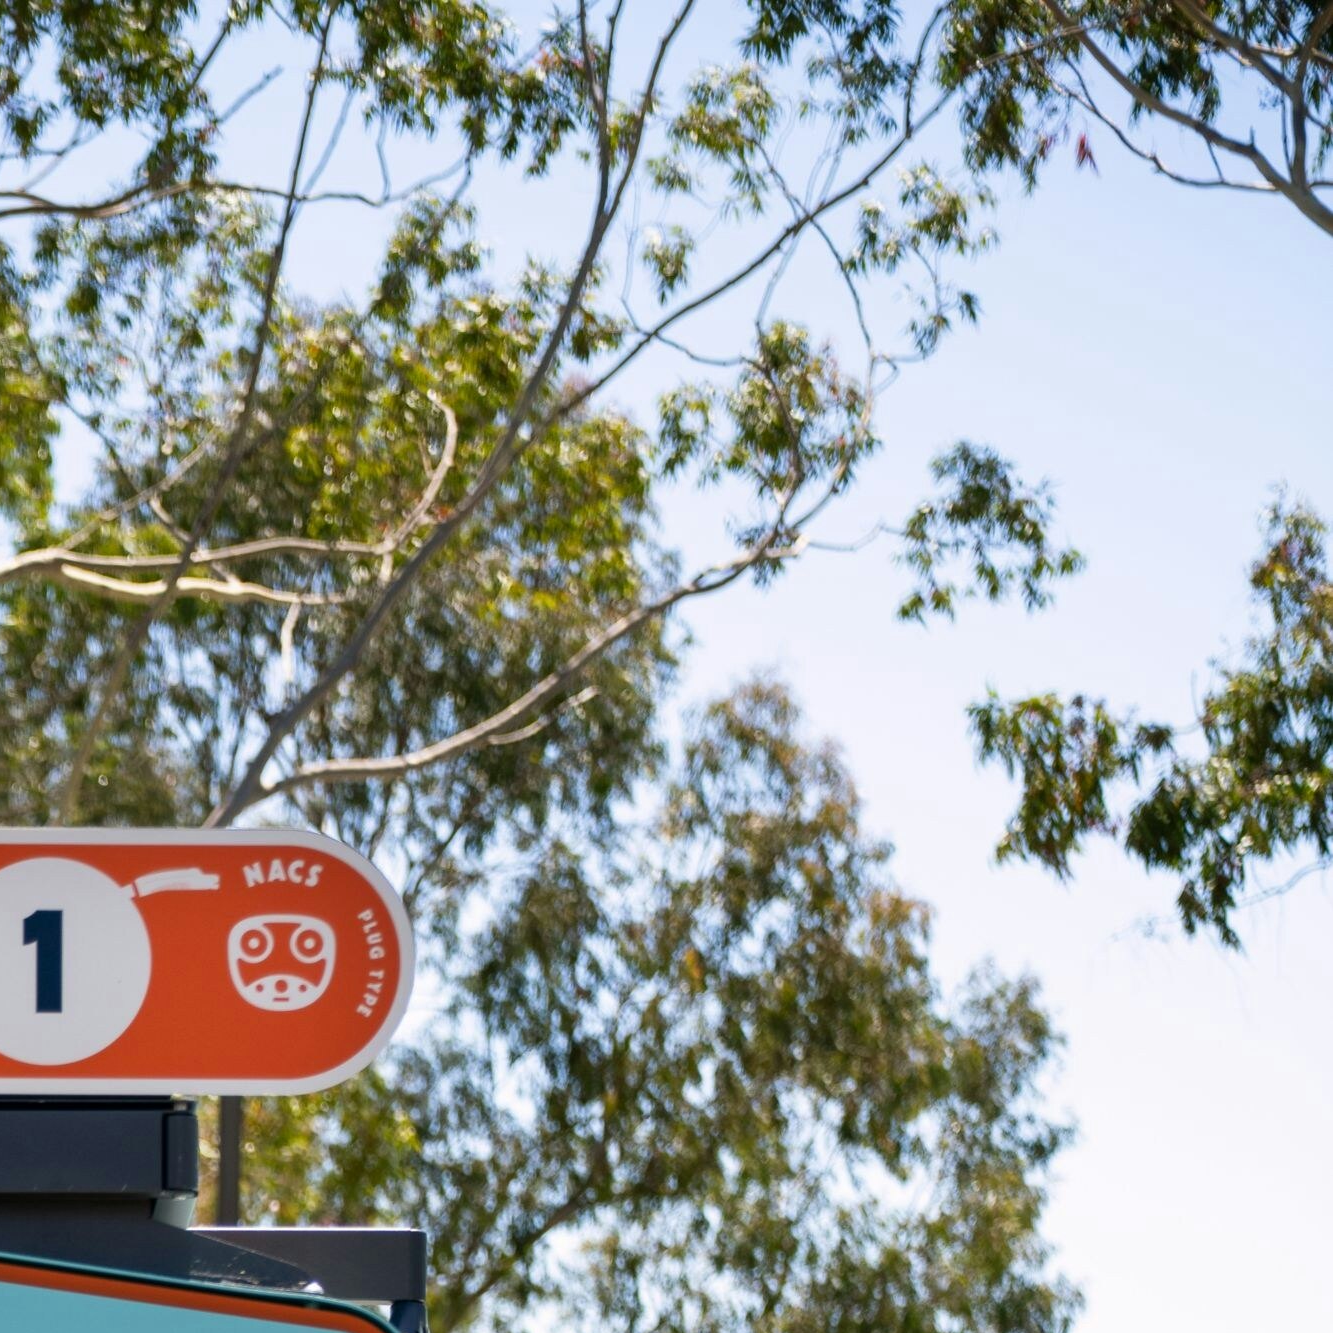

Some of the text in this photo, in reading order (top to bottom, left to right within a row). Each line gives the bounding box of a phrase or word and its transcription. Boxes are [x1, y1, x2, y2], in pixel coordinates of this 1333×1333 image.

[242, 859, 324, 888] NACS
[22, 909, 63, 1013] 1
[356, 908, 386, 1018] PLUG TYPE
